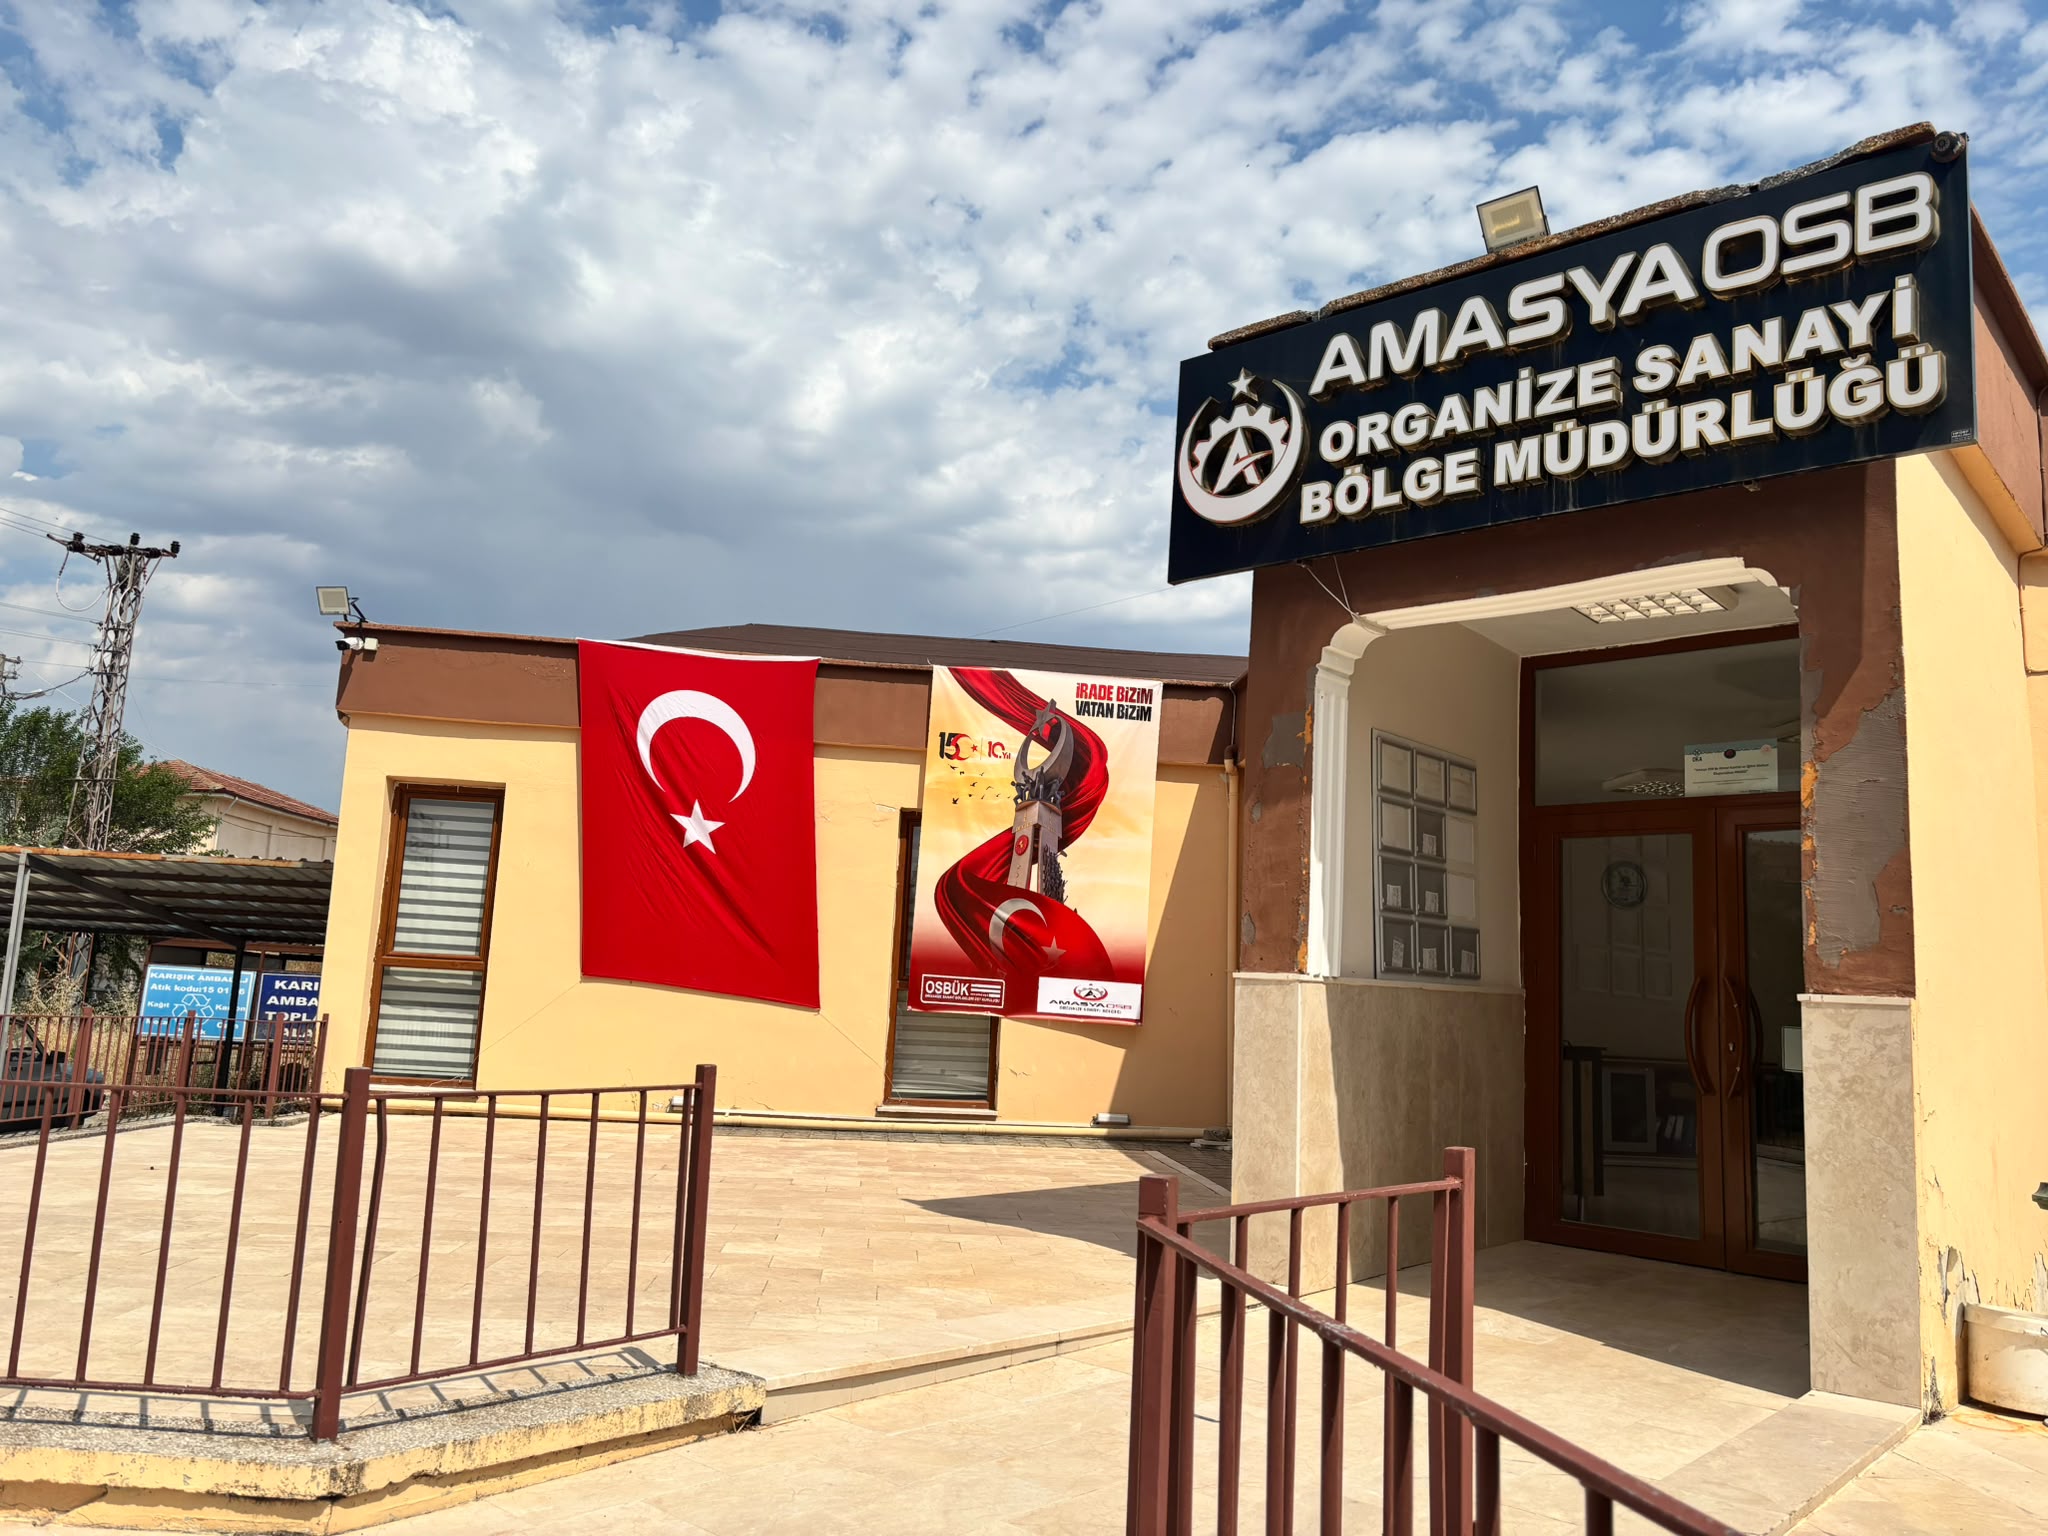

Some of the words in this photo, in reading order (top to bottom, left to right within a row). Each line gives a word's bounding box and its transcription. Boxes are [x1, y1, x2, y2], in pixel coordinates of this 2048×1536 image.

[1319, 356, 1622, 463] ORGANİZE
[1632, 274, 1919, 394] SANAYİ
[1300, 447, 1484, 525] BÖLGE
[1494, 343, 1947, 488] MÜDÜRLÜĞÜ
[1076, 700, 1114, 718] VATAN
[150, 972, 195, 982] KARIŞIK
[150, 983, 172, 991] Atık
[217, 987, 230, 995] 01
[925, 980, 970, 997] OSBÜK
